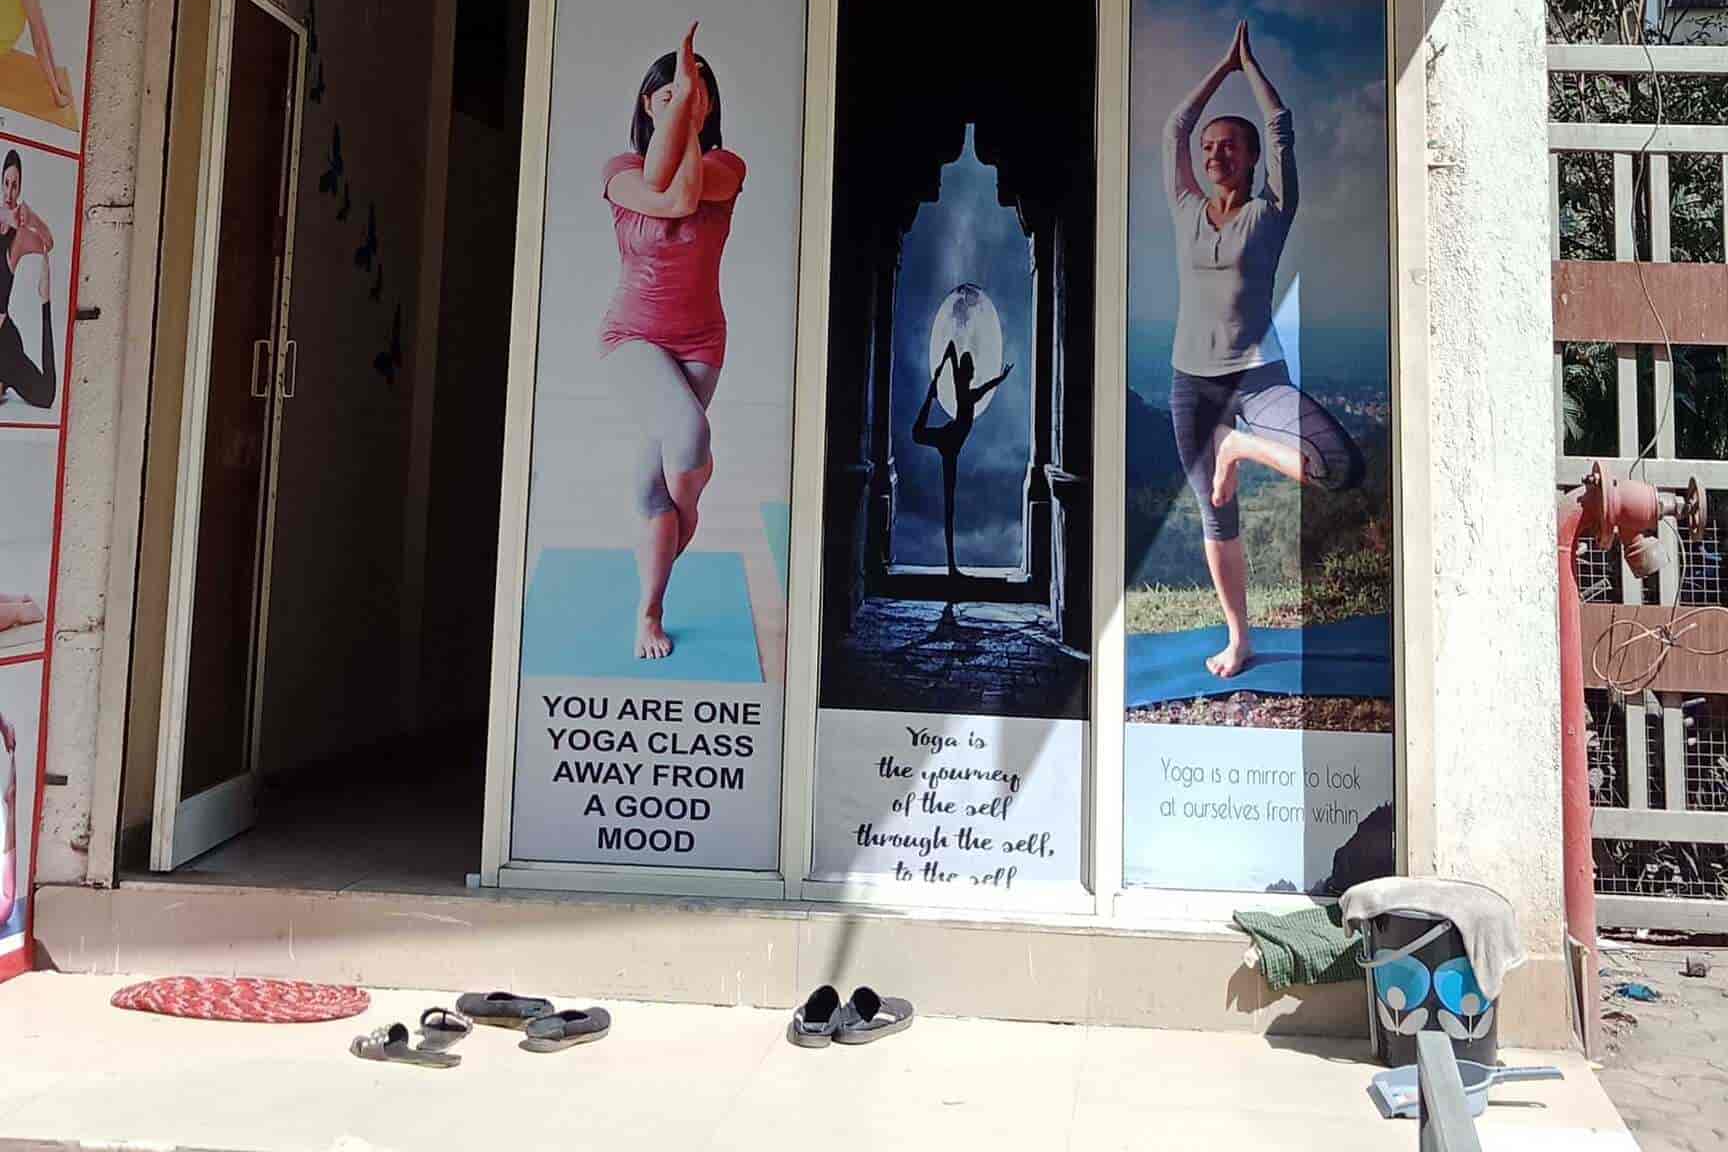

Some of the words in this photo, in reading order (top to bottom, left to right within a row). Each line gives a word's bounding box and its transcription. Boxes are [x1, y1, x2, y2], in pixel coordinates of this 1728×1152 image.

[541, 695, 609, 720] YOU
[616, 698, 684, 723] ARE
[693, 701, 762, 726] ONE
[547, 727, 639, 753] YOGA
[647, 731, 754, 758] CLASS
[905, 726, 958, 754] Yoga
[967, 731, 987, 749] is
[552, 760, 644, 785] AWAY
[652, 764, 745, 790] FROM
[873, 755, 914, 779] the
[1160, 755, 1205, 788] Yoga
[1210, 766, 1222, 785] is
[1228, 767, 1241, 785] a
[1246, 766, 1297, 787] mirror
[1303, 765, 1321, 789] to
[1326, 764, 1362, 791] look
[583, 794, 606, 817] A
[614, 794, 711, 821] GOOD
[891, 791, 917, 817] of
[917, 790, 958, 814] the
[965, 795, 1014, 821] self
[1159, 795, 1176, 817] at
[1182, 794, 1261, 822] ourselves
[1266, 799, 1305, 825] from
[1312, 799, 1360, 826] within
[597, 826, 696, 853] MOOD
[851, 822, 949, 857] through
[951, 826, 994, 851] the
[1001, 831, 1055, 858] self,
[892, 860, 913, 882] to
[918, 860, 960, 884] the
[969, 865, 1019, 889] self
